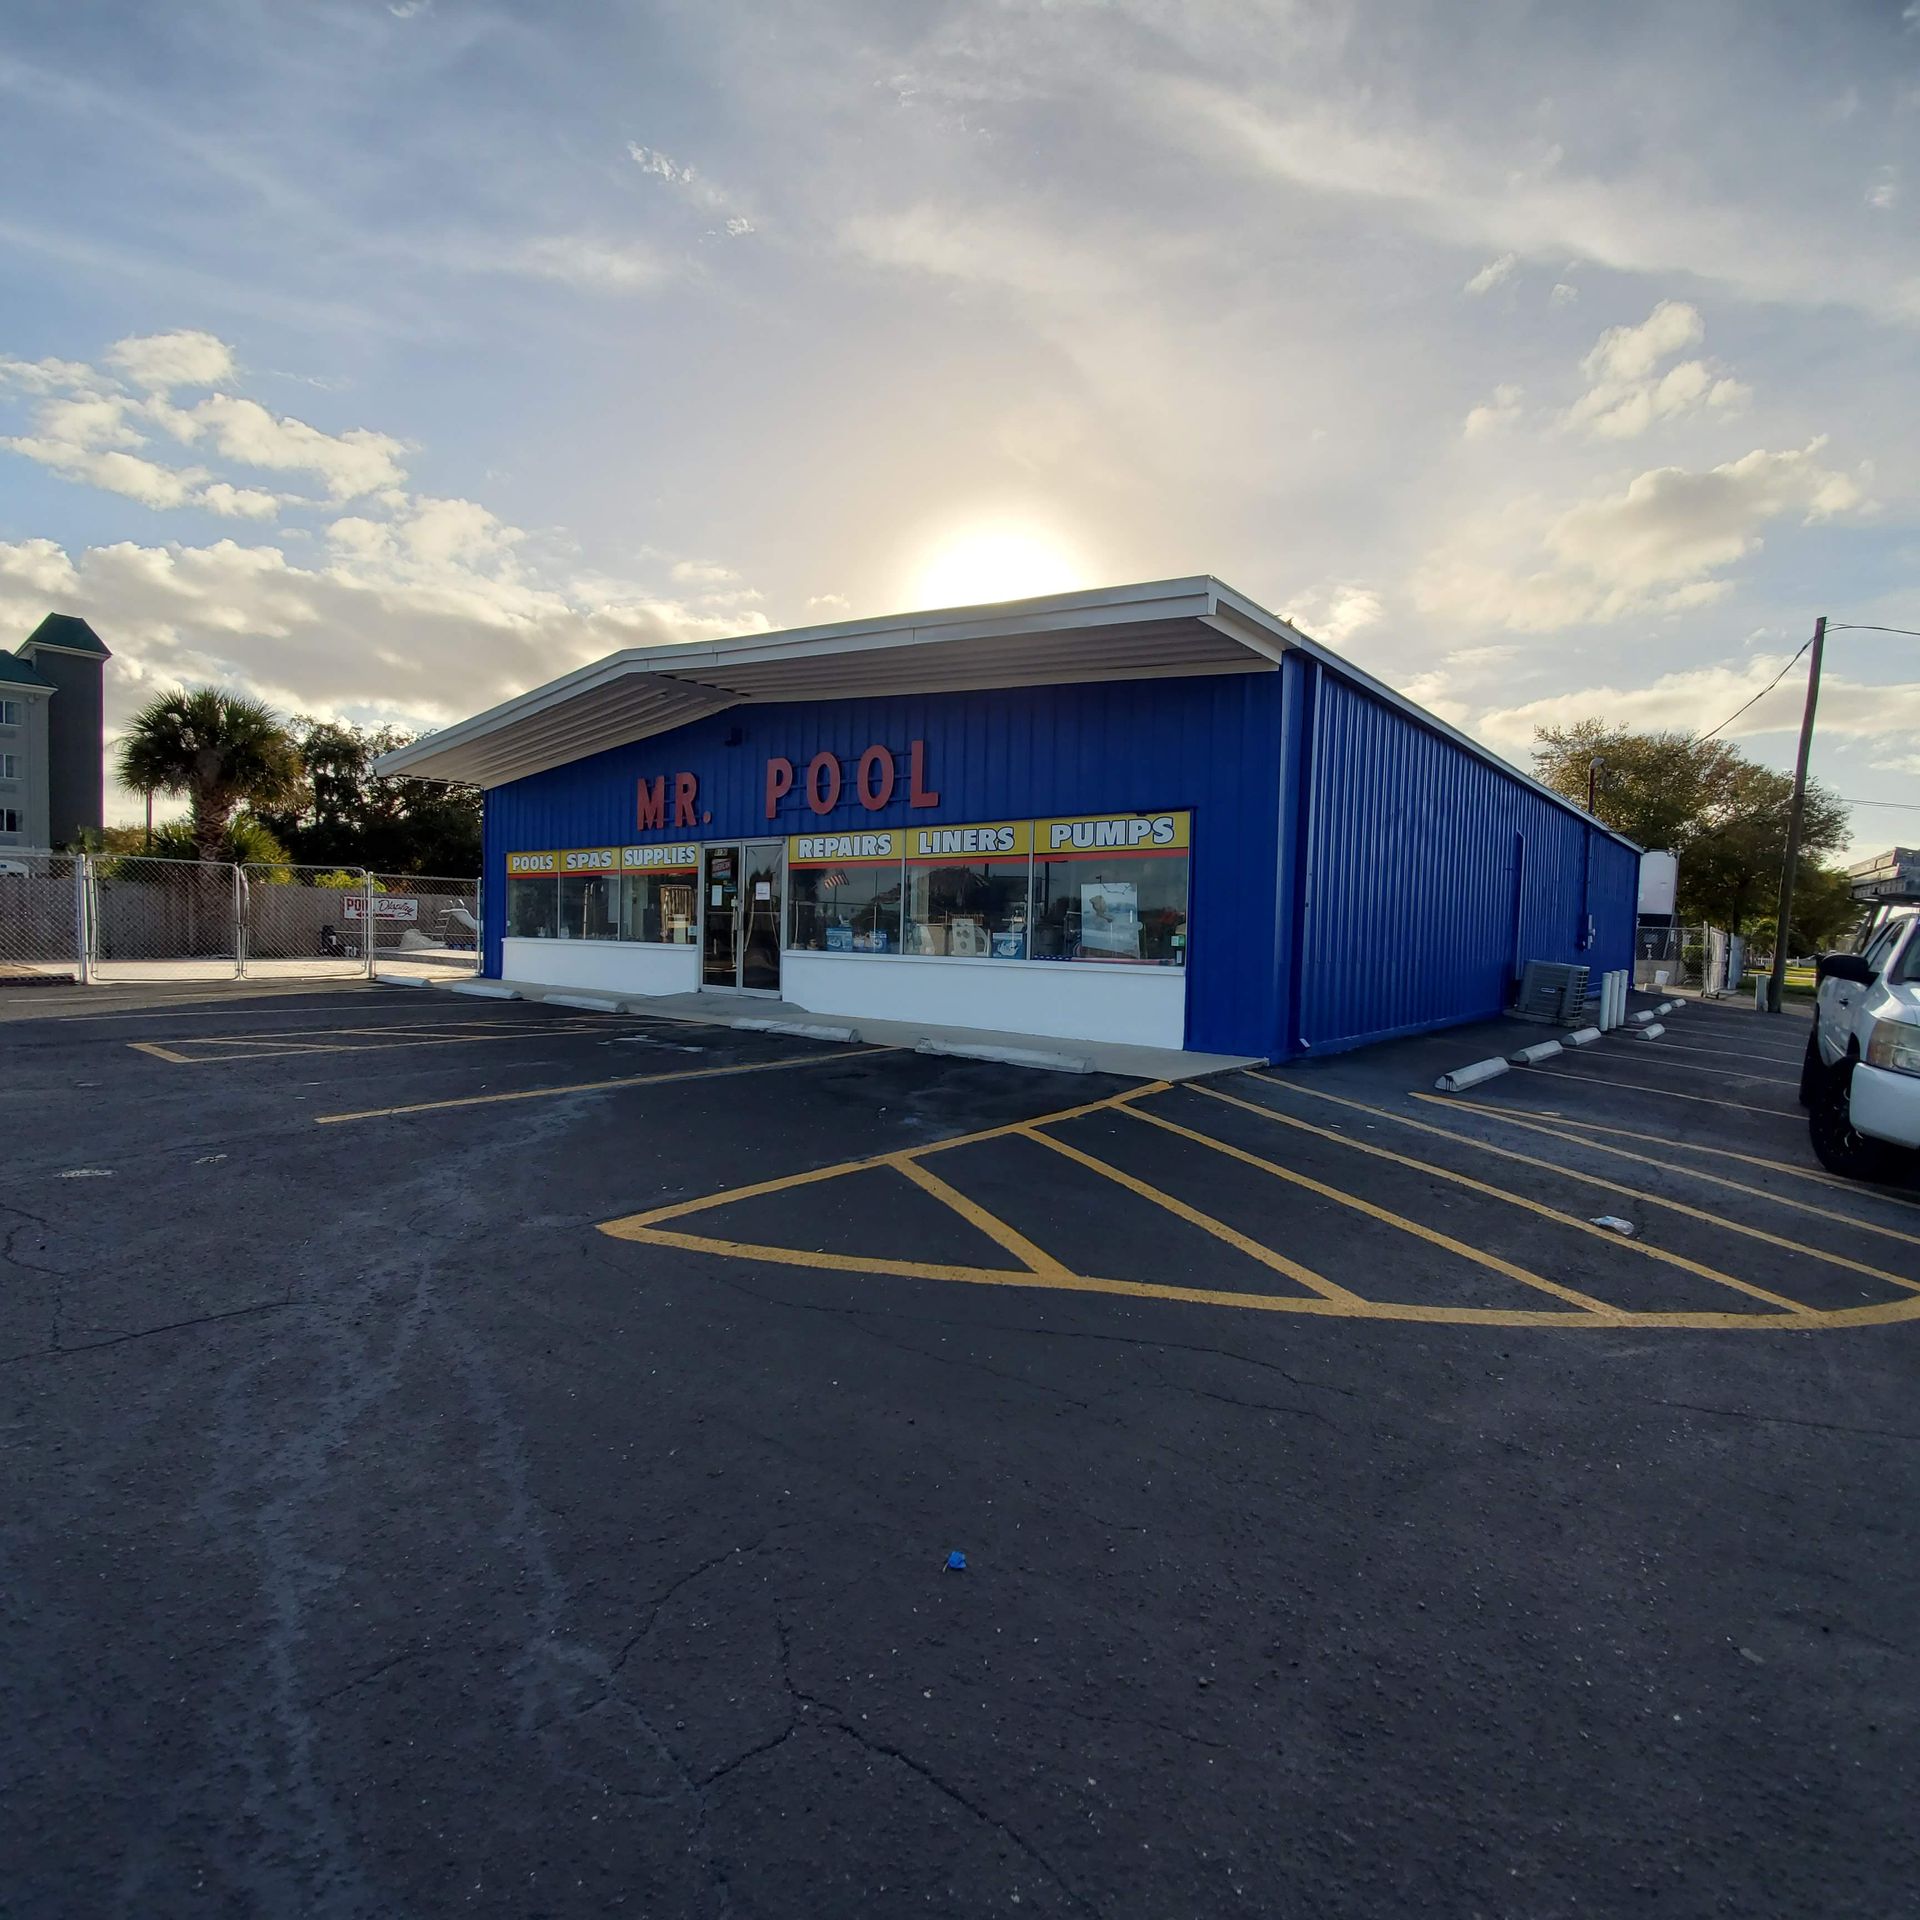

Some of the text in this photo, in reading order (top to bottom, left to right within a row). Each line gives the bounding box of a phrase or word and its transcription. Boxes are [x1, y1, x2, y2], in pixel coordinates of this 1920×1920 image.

[637, 740, 939, 831] MR. POOL
[918, 827, 1016, 855] LINERS
[1050, 816, 1175, 849] PUMPS
[623, 845, 697, 867] SUPPLIES
[798, 833, 893, 859] REPAIRS
[511, 854, 554, 872] POOLS
[566, 850, 613, 871] SPAS
[346, 898, 415, 917] POO Display
